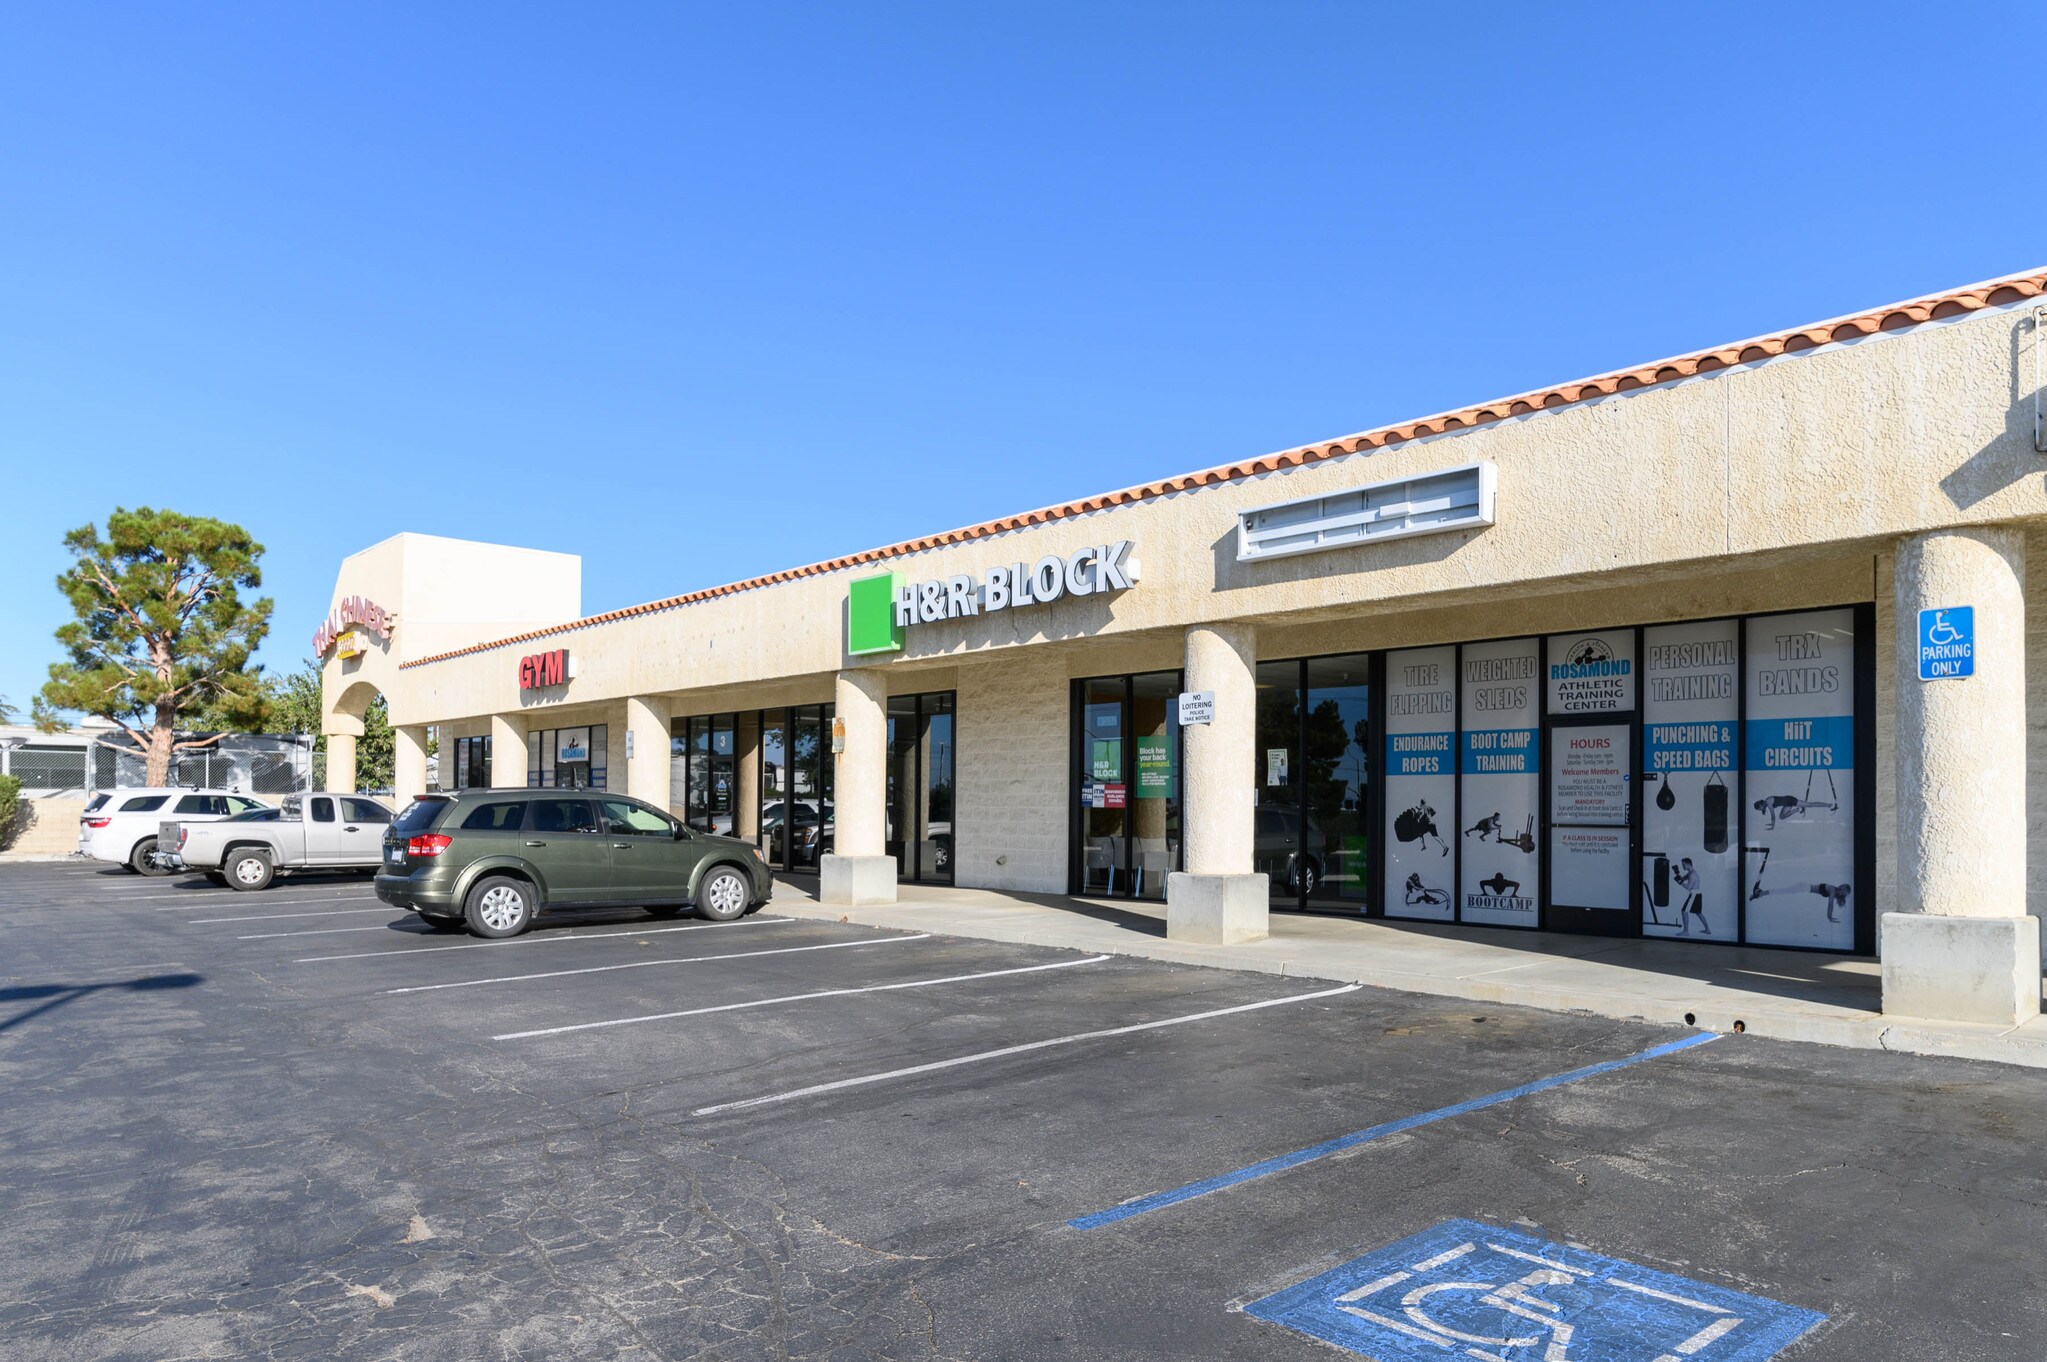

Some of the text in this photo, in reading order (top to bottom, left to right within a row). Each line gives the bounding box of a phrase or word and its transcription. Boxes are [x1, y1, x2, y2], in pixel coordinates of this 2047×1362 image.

[896, 540, 1135, 626] H&R BLOCK
[312, 595, 390, 658] THAI CHINESE
[1650, 640, 1735, 670] PERSONAL
[1775, 633, 1821, 661] TRX
[1922, 644, 1971, 660] PARKING
[519, 649, 566, 689] GYM
[1404, 664, 1438, 687] TIRE
[1466, 656, 1537, 683] WEIGHTED
[1551, 659, 1631, 680] ROSAMOND
[1931, 660, 1961, 676] ONLY
[1559, 679, 1623, 691] ATHLETIC
[1651, 673, 1732, 702] TRAINING
[1759, 666, 1839, 696] BANDS
[1391, 691, 1452, 715] FLIPPING
[1475, 686, 1527, 711] SLEDS
[1558, 689, 1623, 700] TRAINING
[1182, 701, 1212, 710] LOITERING
[1564, 700, 1616, 710] CENTER
[720, 736, 726, 747] 3
[1394, 735, 1448, 751] ENDURANCE
[1471, 732, 1530, 749] BOOT CAMP
[1652, 725, 1730, 744] PUNCHING &
[1139, 746, 1166, 755] Block has
[1570, 738, 1611, 749] HOURS
[1093, 761, 1109, 769] H&R
[1152, 753, 1166, 761] back
[1402, 757, 1439, 772] ROPES
[1476, 754, 1525, 771] TRAINING
[1653, 750, 1729, 769] SPEED BAGS
[1765, 747, 1832, 767] CIRCUITS
[1093, 769, 1118, 777] BLOCK
[1590, 767, 1619, 776] Members
[1467, 896, 1533, 910] BOOTCAMP
